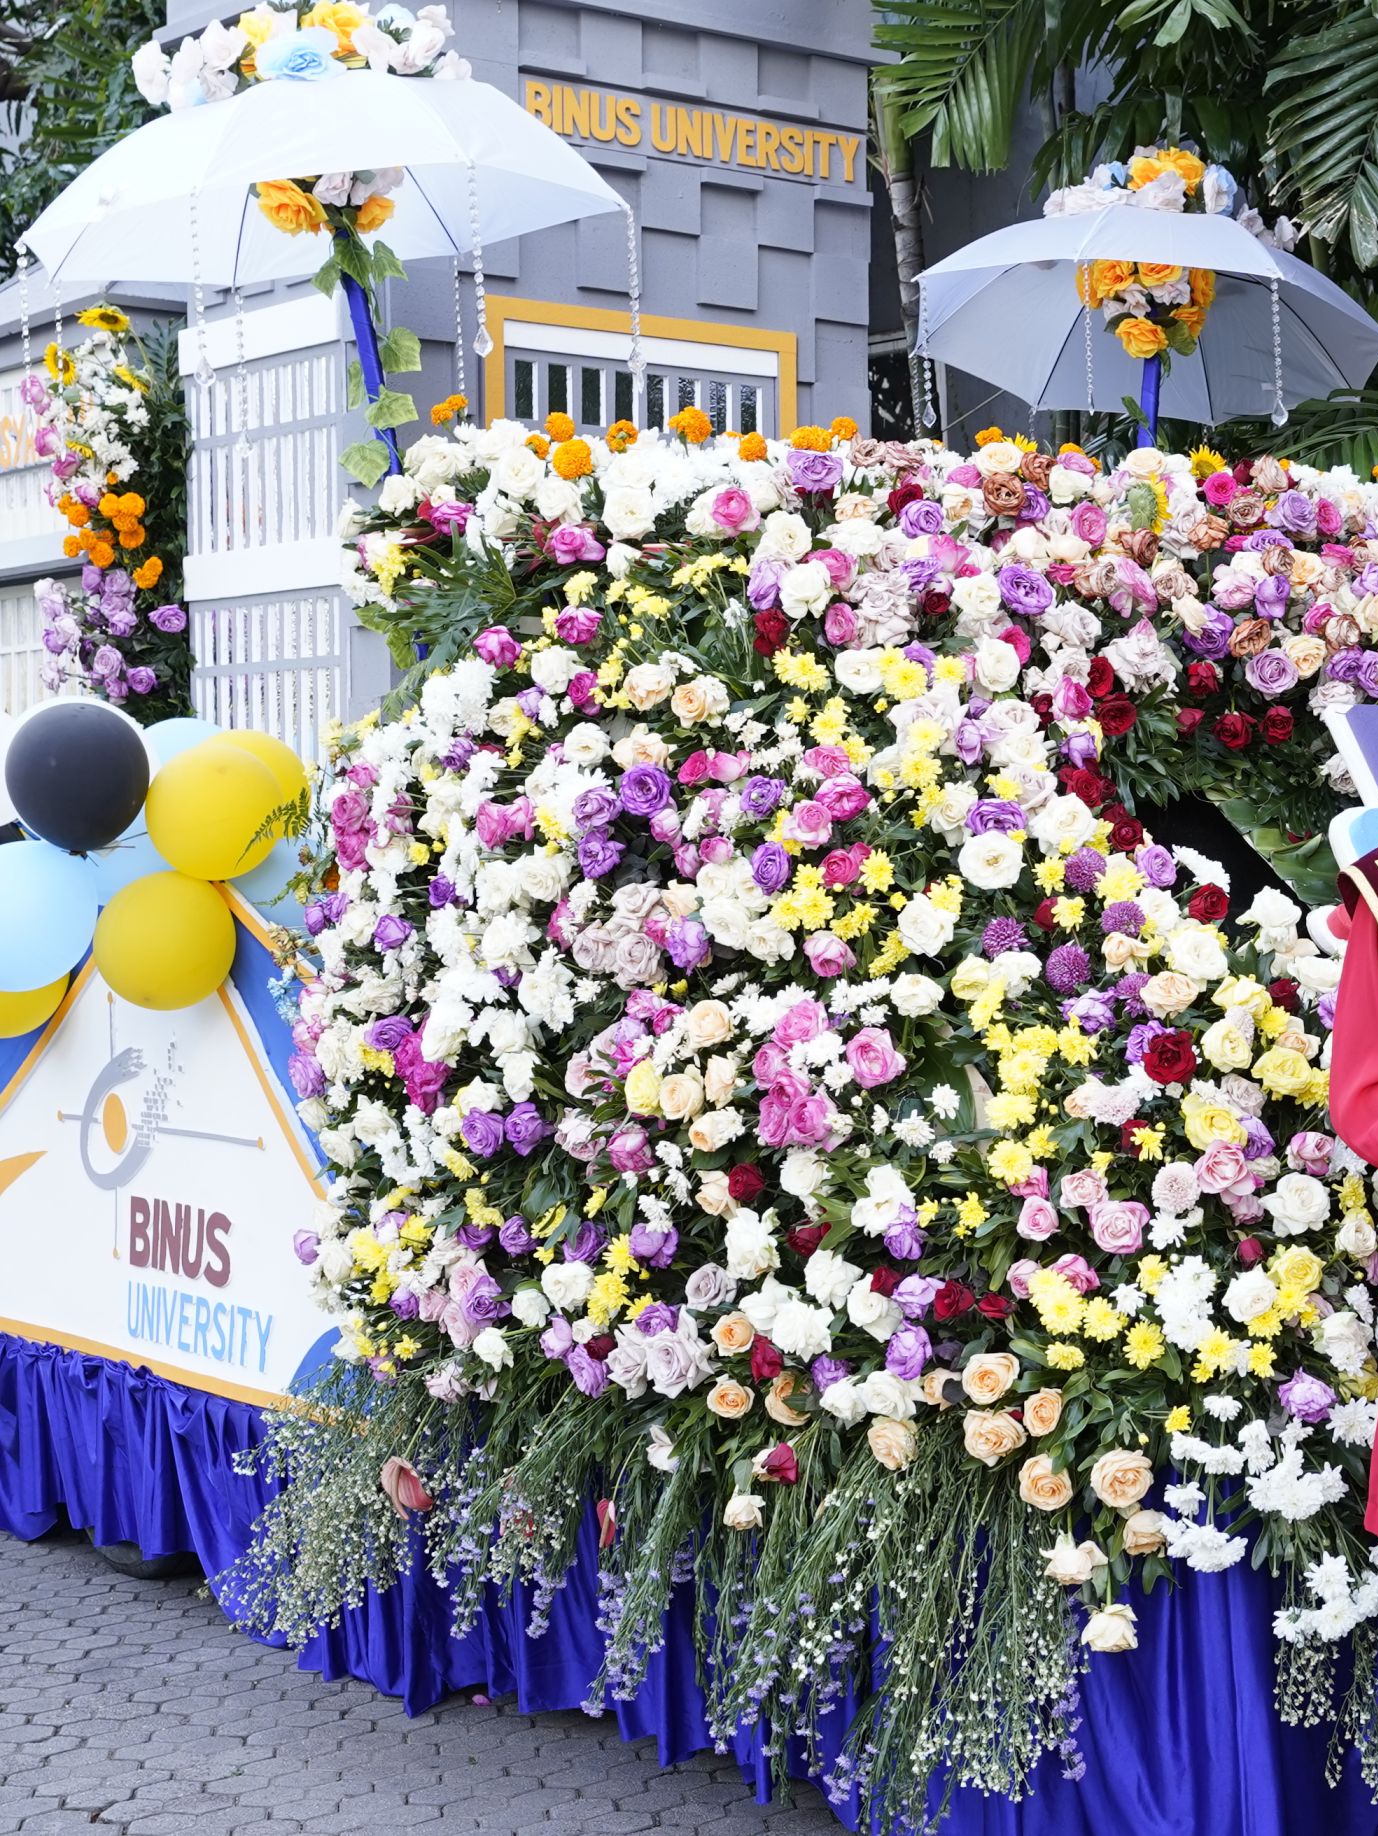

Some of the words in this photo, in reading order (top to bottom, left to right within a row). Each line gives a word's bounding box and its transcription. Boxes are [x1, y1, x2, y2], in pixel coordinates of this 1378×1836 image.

[525, 80, 642, 147] BINUS
[650, 102, 860, 182] UNIVERSITY
[129, 1195, 232, 1288] BINUS
[127, 1280, 273, 1373] UNIVERSITY
